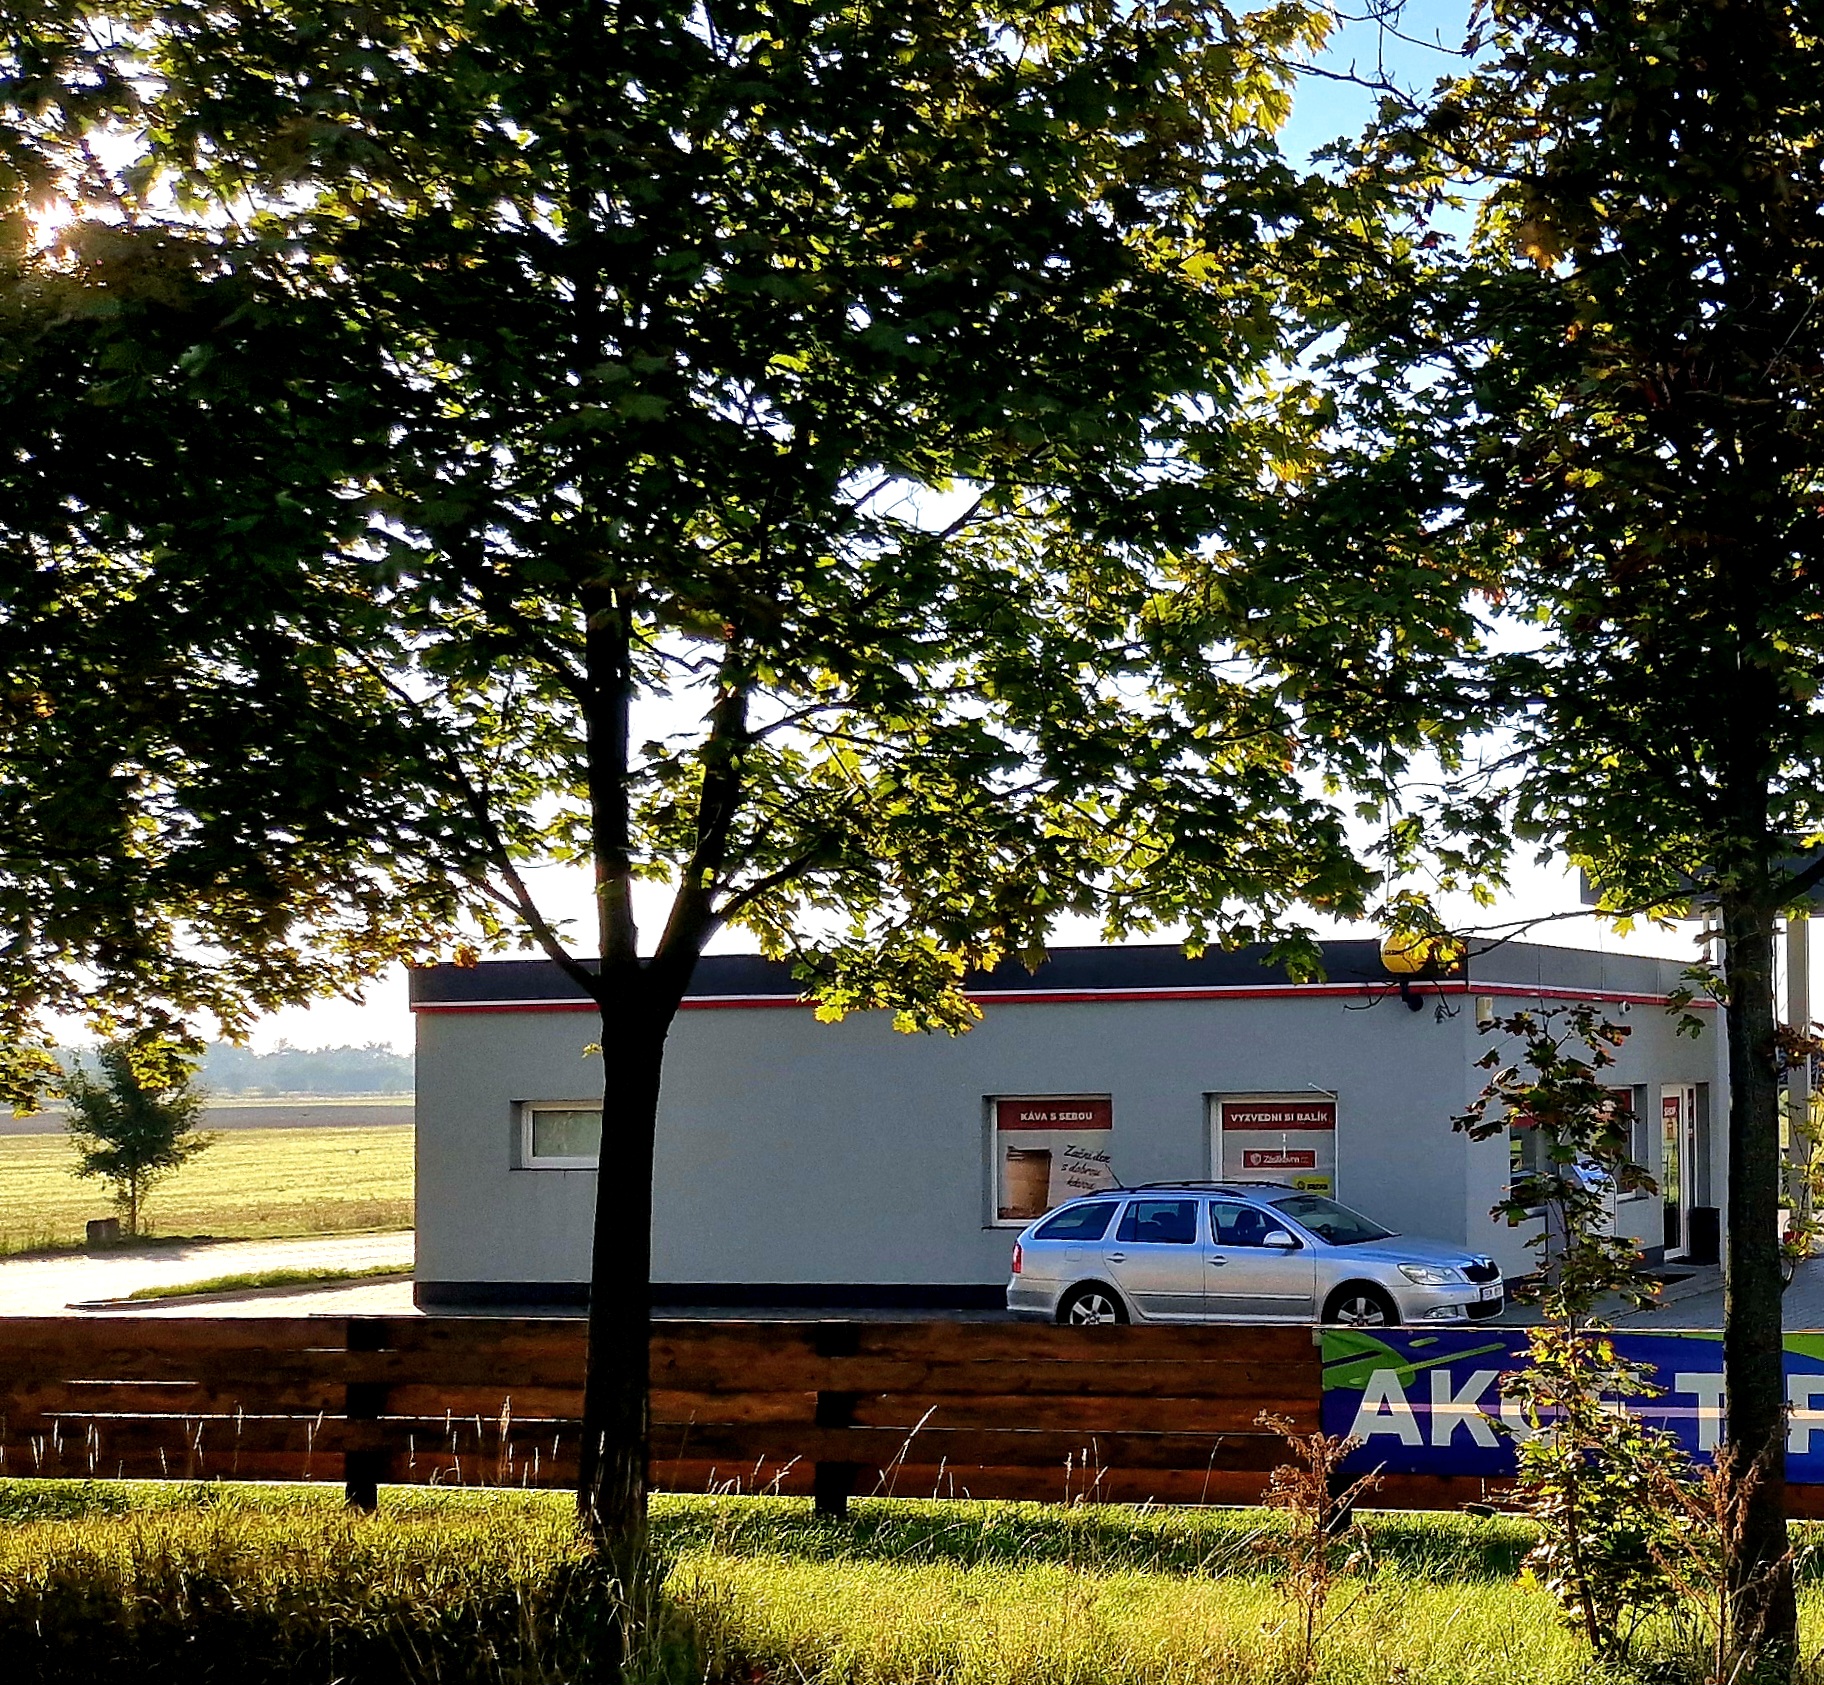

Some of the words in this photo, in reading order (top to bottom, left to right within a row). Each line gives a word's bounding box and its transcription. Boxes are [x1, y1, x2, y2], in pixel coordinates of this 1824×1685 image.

[1020, 1110, 1048, 1121] KÁVA
[1050, 1112, 1057, 1121] S
[1059, 1112, 1093, 1121] SEBOU
[1230, 1112, 1282, 1122] VYZVEDNI
[1284, 1112, 1294, 1122] SI
[1296, 1110, 1328, 1122] BALÍK
